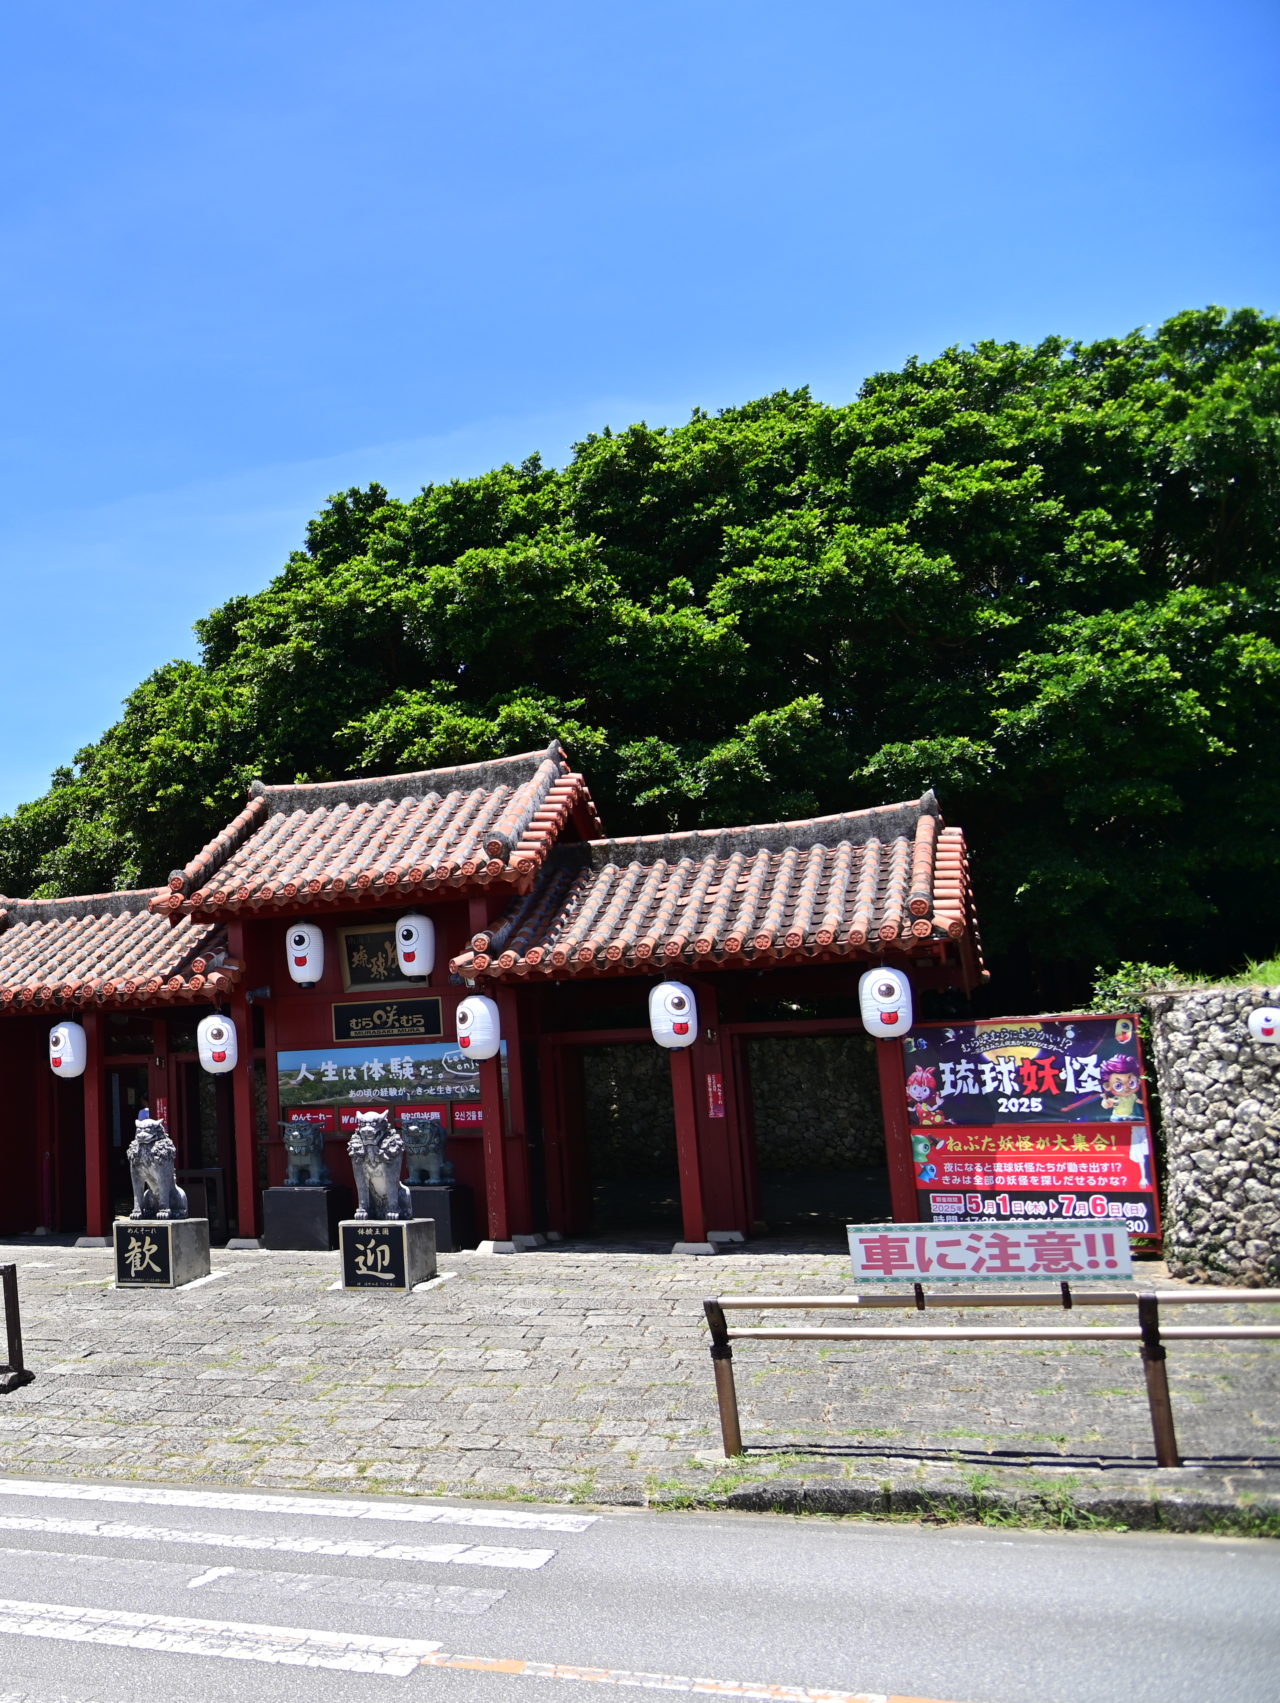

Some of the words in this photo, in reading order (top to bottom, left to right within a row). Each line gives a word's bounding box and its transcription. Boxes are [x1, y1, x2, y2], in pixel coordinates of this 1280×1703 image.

[350, 1005, 424, 1030] むら咲むら
[296, 1056, 443, 1081] 人生は体験だ。
[939, 1055, 1103, 1095] 琉球妖怪
[349, 1085, 480, 1098] あの頃の経験が、きっと生きている。
[998, 1098, 1042, 1113] 2025
[946, 1134, 1117, 1152] ねぶた妖怪が大集合!
[944, 1162, 1122, 1173] 夜になると琉球妖怪たちが動き出す!?
[942, 1175, 1128, 1186] きみは全部の妖怪を探しだせるかな?
[932, 1204, 963, 1213] 2025年
[354, 1238, 396, 1280] 迎
[859, 1231, 1118, 1275] 車に注意!!
